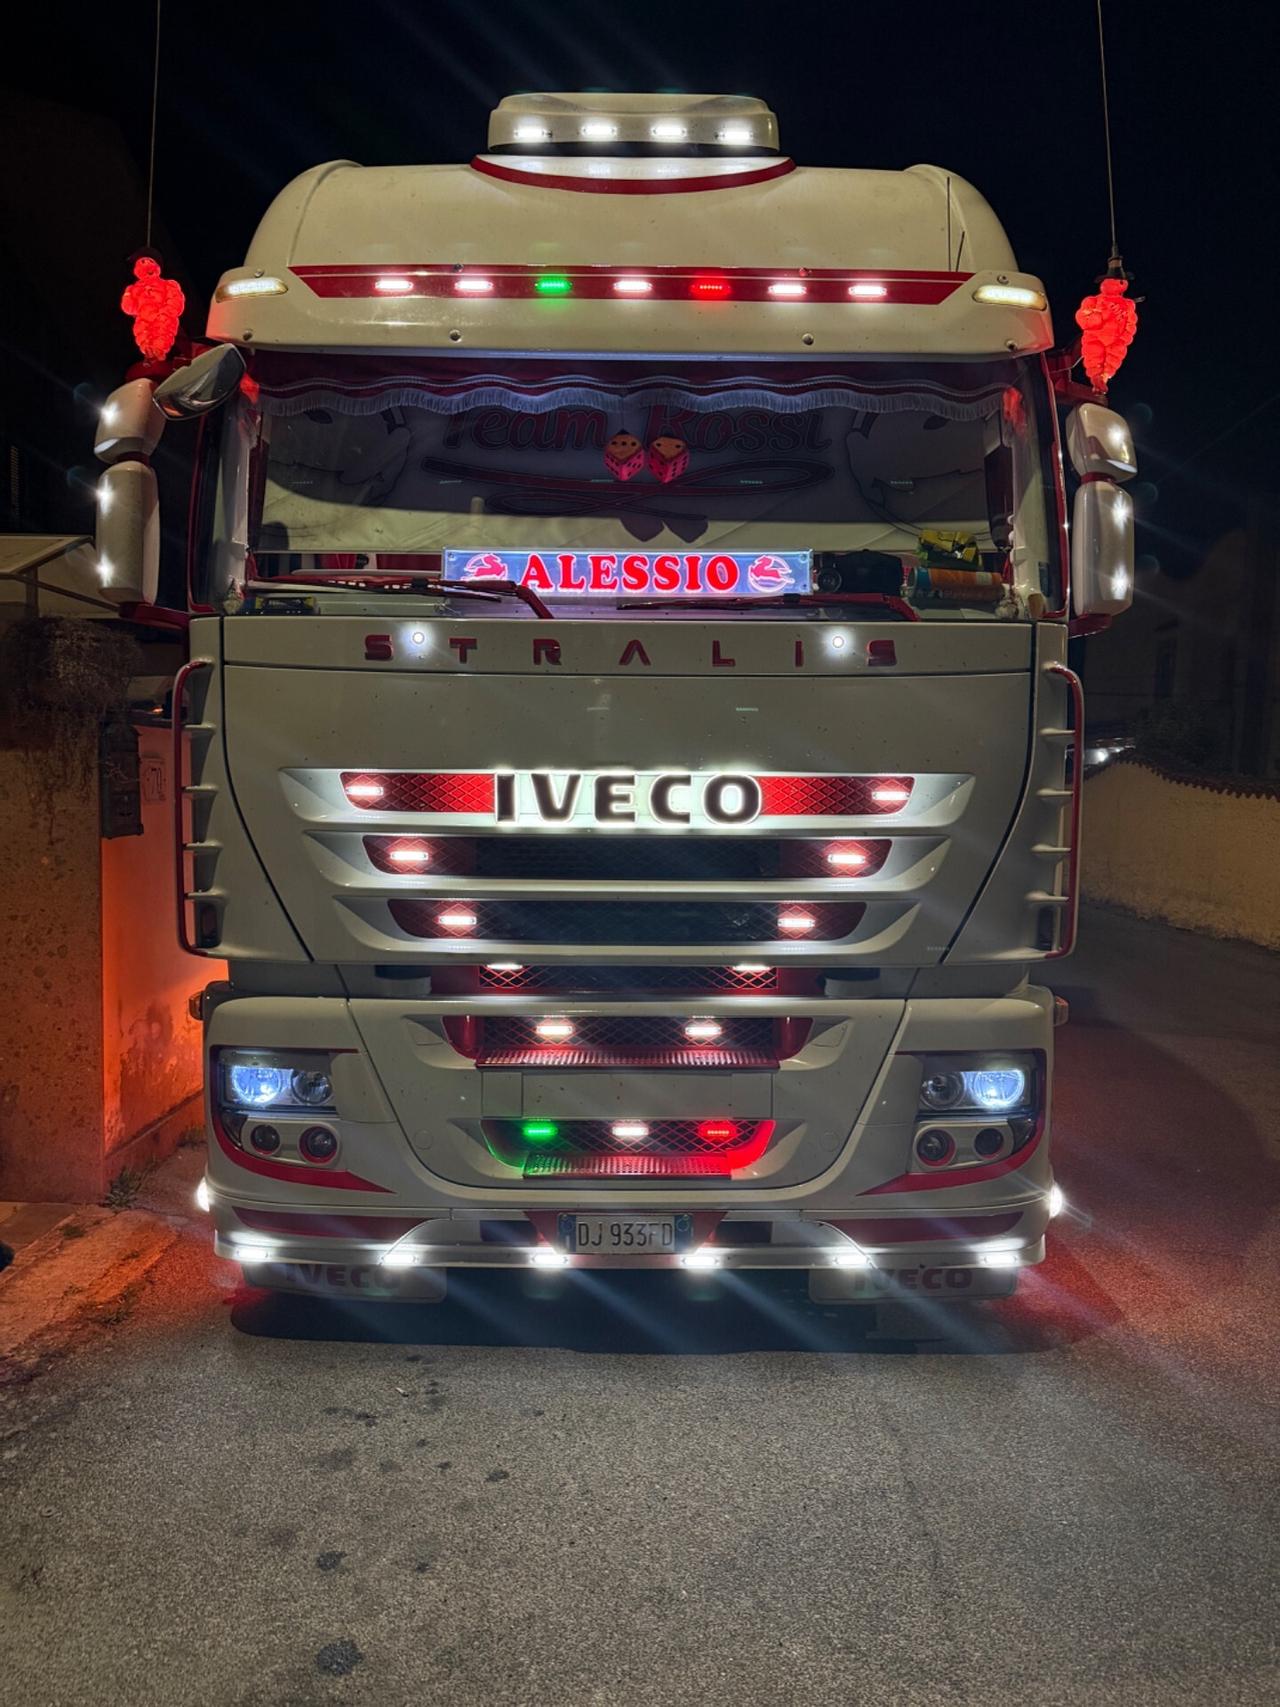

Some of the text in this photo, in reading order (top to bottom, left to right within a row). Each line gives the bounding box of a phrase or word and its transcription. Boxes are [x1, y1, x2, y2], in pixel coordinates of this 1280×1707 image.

[441, 405, 831, 452] Team Rossi
[519, 552, 741, 593] ALESSIO
[364, 633, 897, 667] STRALIS
[494, 771, 763, 826] IVECO
